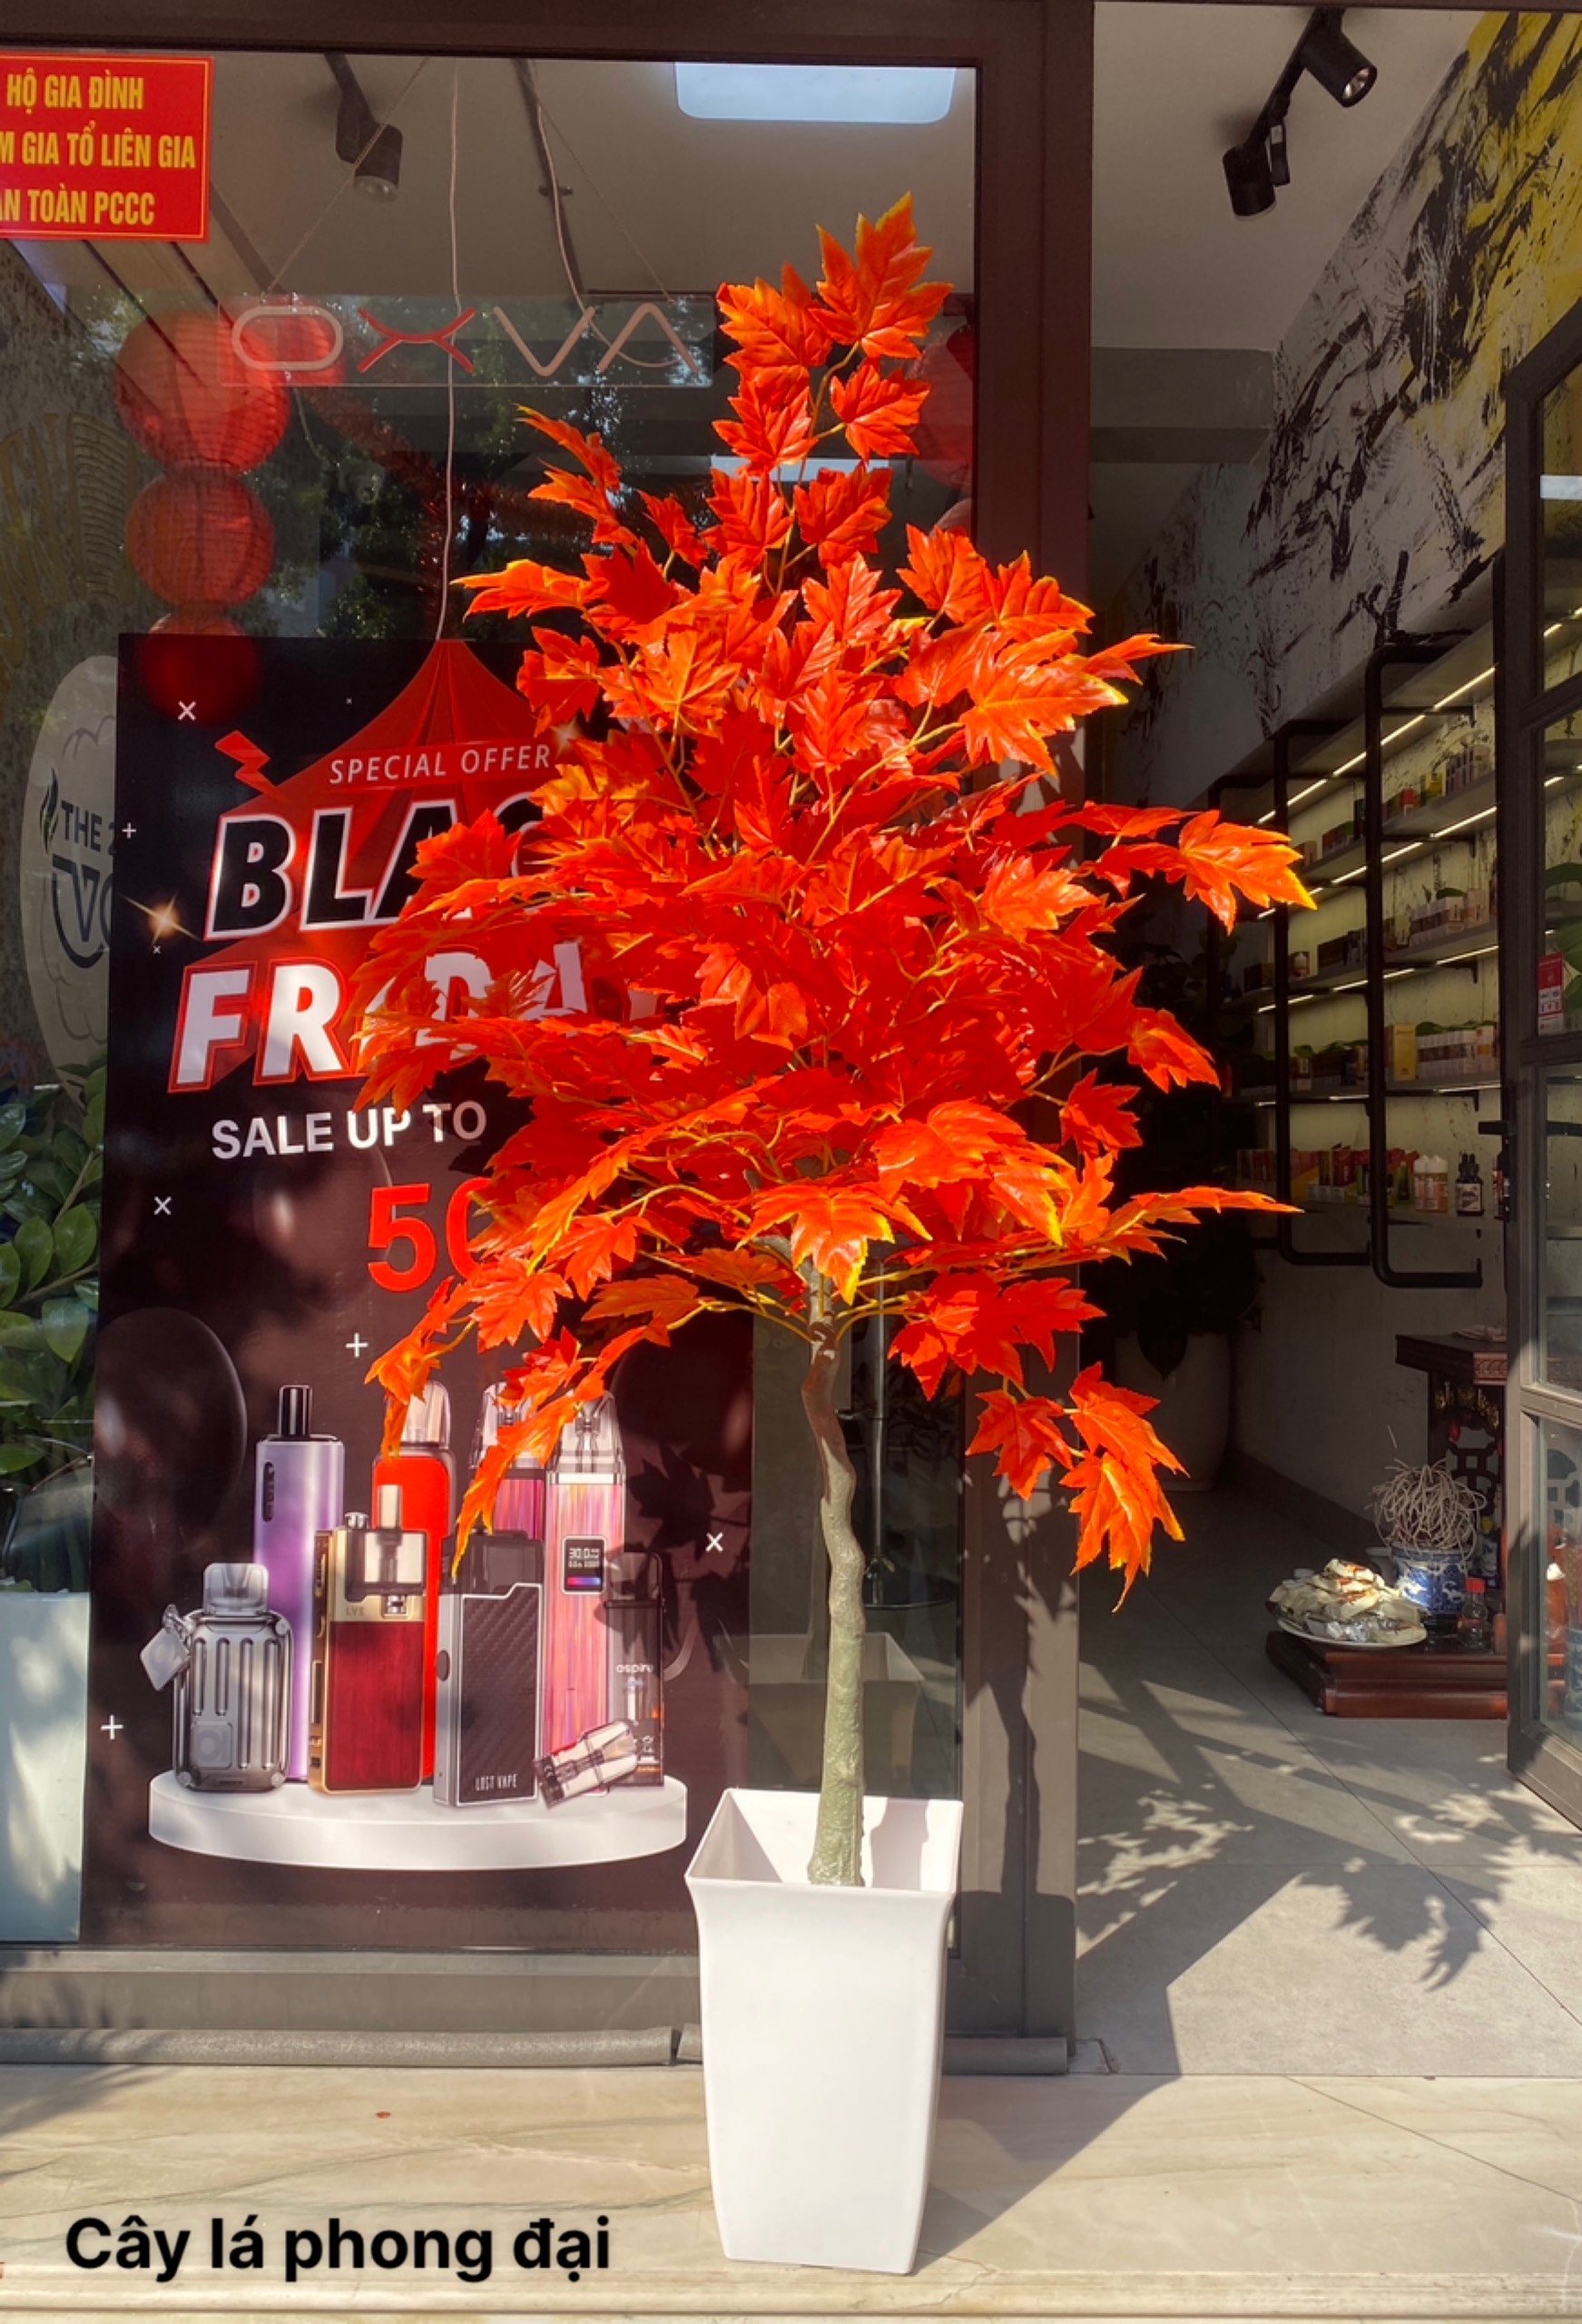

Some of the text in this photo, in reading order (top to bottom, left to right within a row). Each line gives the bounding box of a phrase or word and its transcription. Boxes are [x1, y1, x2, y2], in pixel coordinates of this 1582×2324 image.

[6, 67, 144, 114] HỘ GIA ĐÌNH
[22, 131, 60, 165] GIA
[67, 120, 96, 166] TỔ
[101, 127, 152, 168] LIÊN
[158, 135, 196, 169] GIA
[27, 182, 88, 223] TOÀN
[93, 191, 155, 226] PCCC
[232, 305, 700, 376] OXVA
[329, 744, 551, 785] SPECIAL OFFER
[61, 799, 102, 853] THE
[211, 1100, 486, 1160] SALE UP TO
